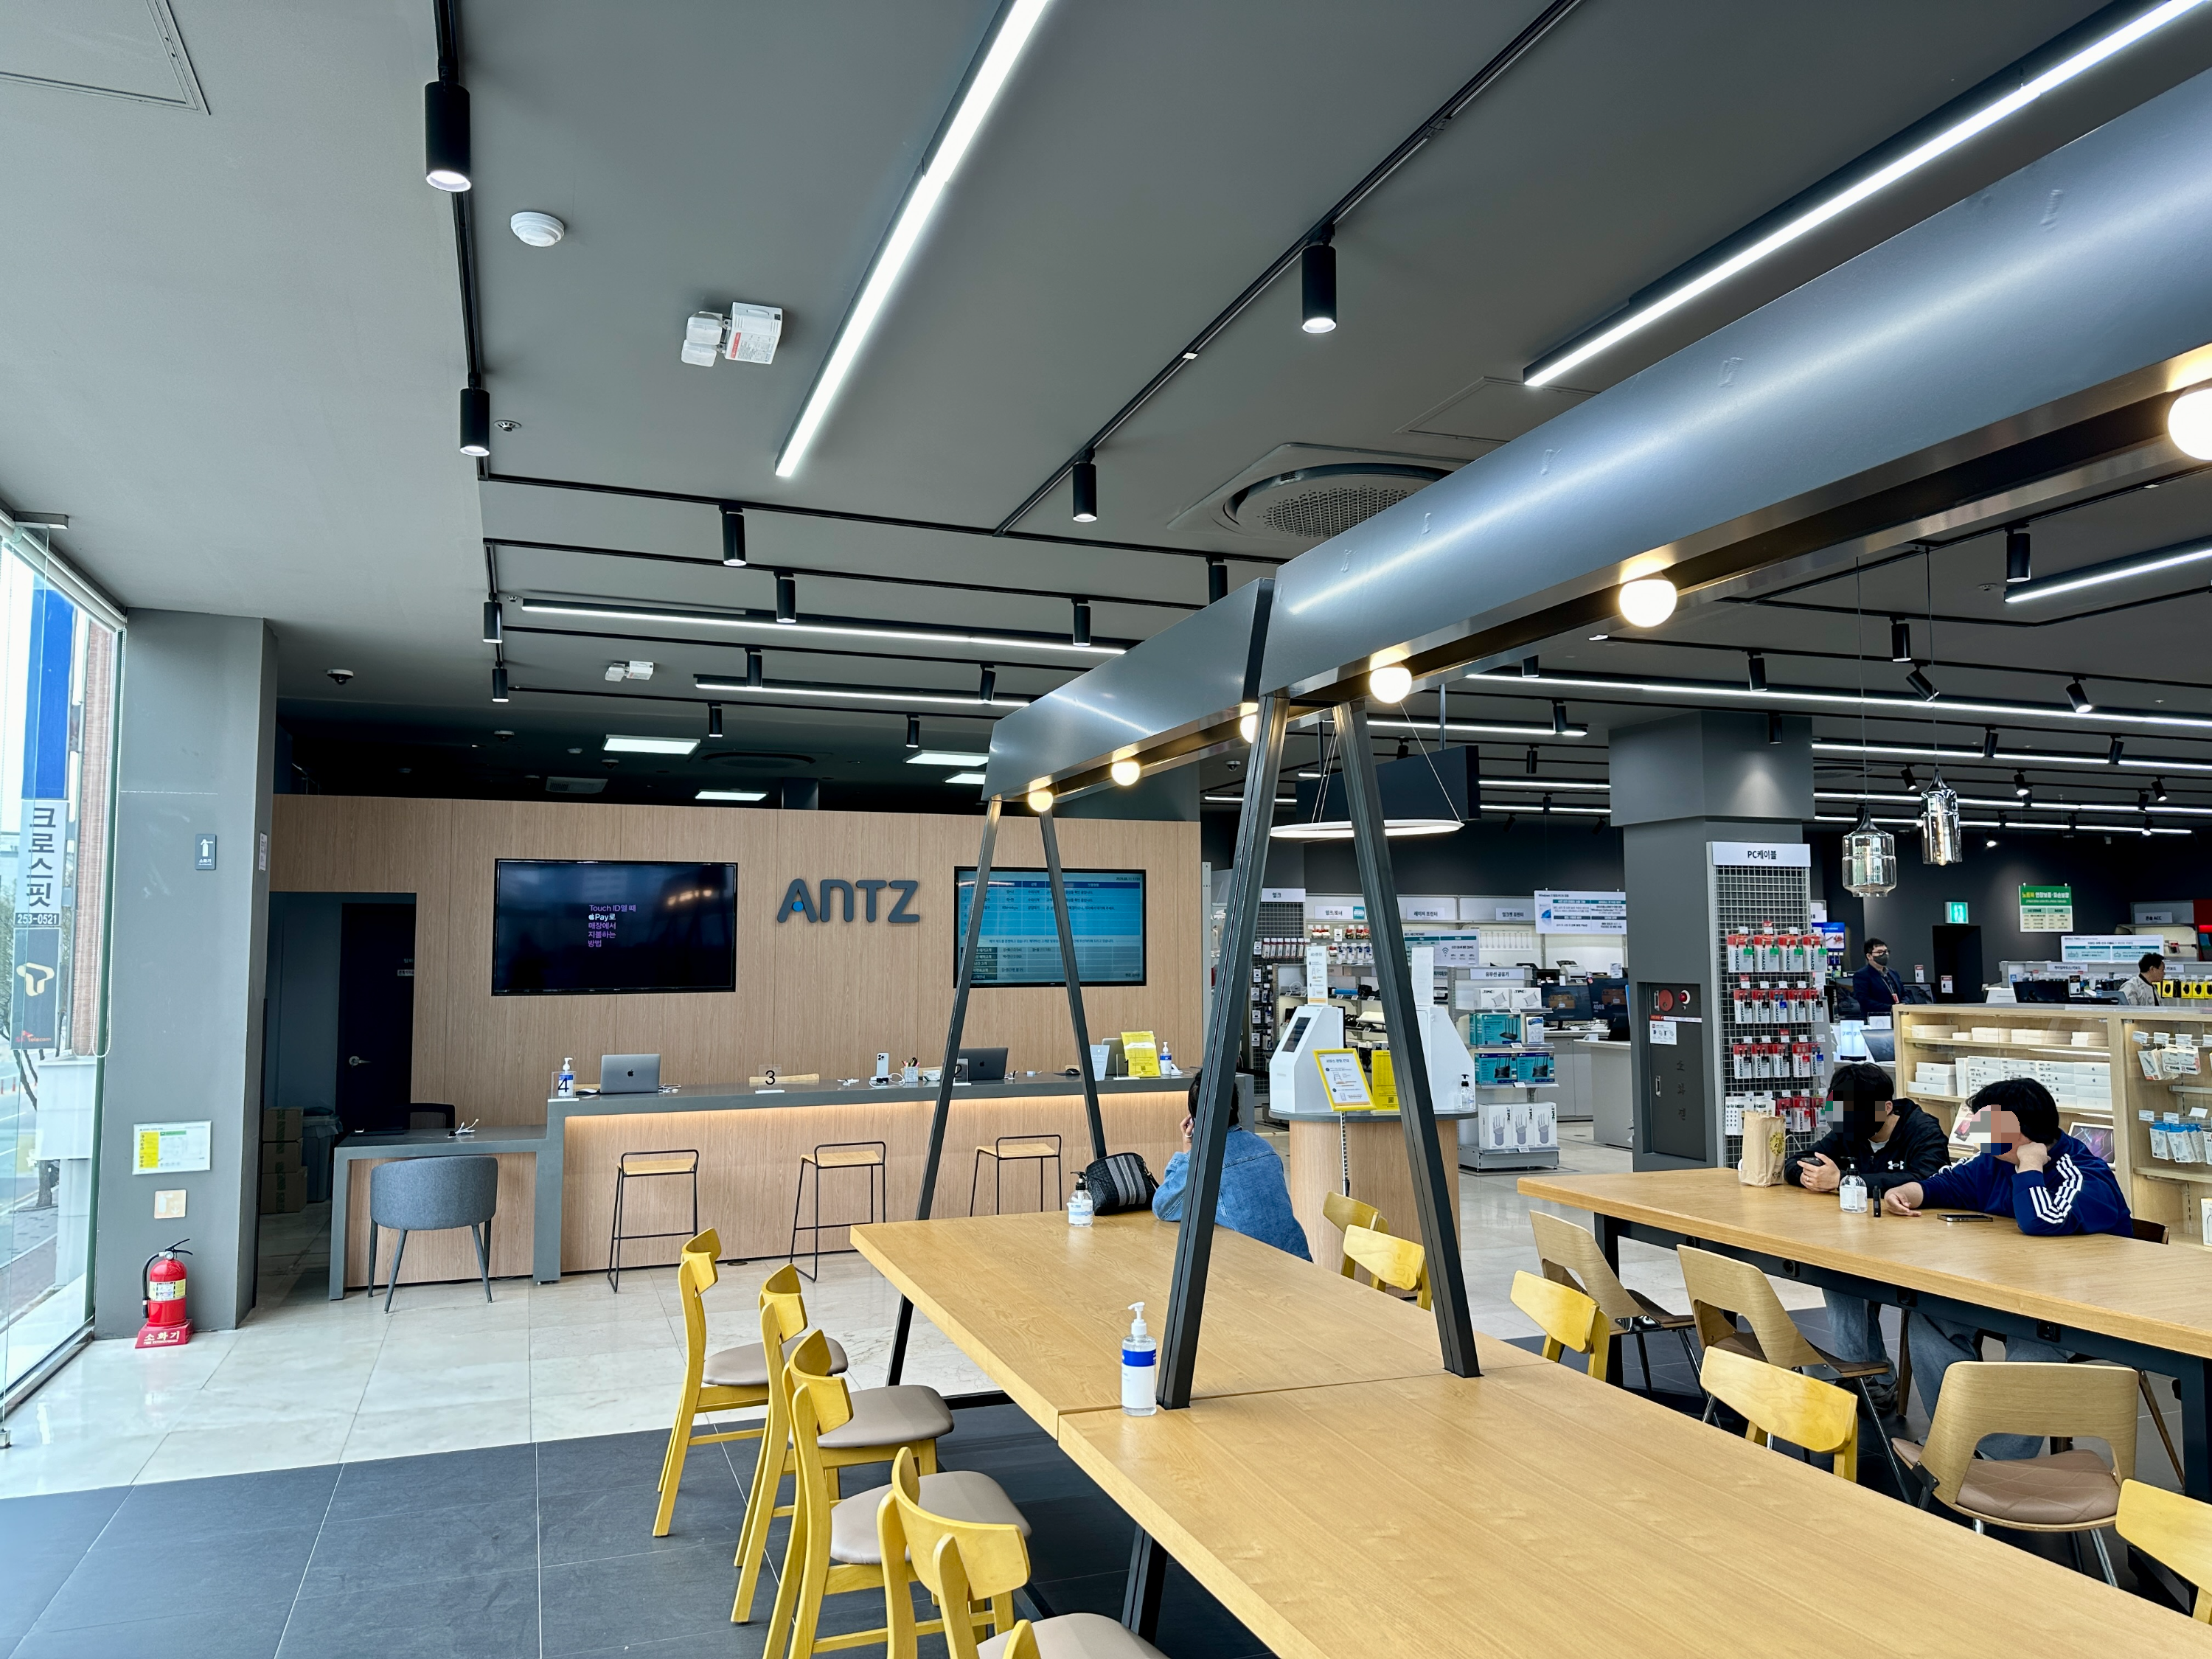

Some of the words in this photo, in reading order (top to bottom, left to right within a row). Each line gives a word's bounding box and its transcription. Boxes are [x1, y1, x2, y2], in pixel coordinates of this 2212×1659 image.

[27, 807, 56, 907] 크로스핏
[1747, 850, 1777, 860] PC케이블
[777, 878, 920, 923] ANTZ
[17, 914, 57, 925] 253-0521
[588, 931, 616, 939] 지불하는
[588, 939, 602, 947] 방법
[765, 1070, 776, 1085] 3
[954, 1064, 962, 1078] 2
[557, 1077, 569, 1093] 4
[144, 1330, 180, 1342] 소화기
